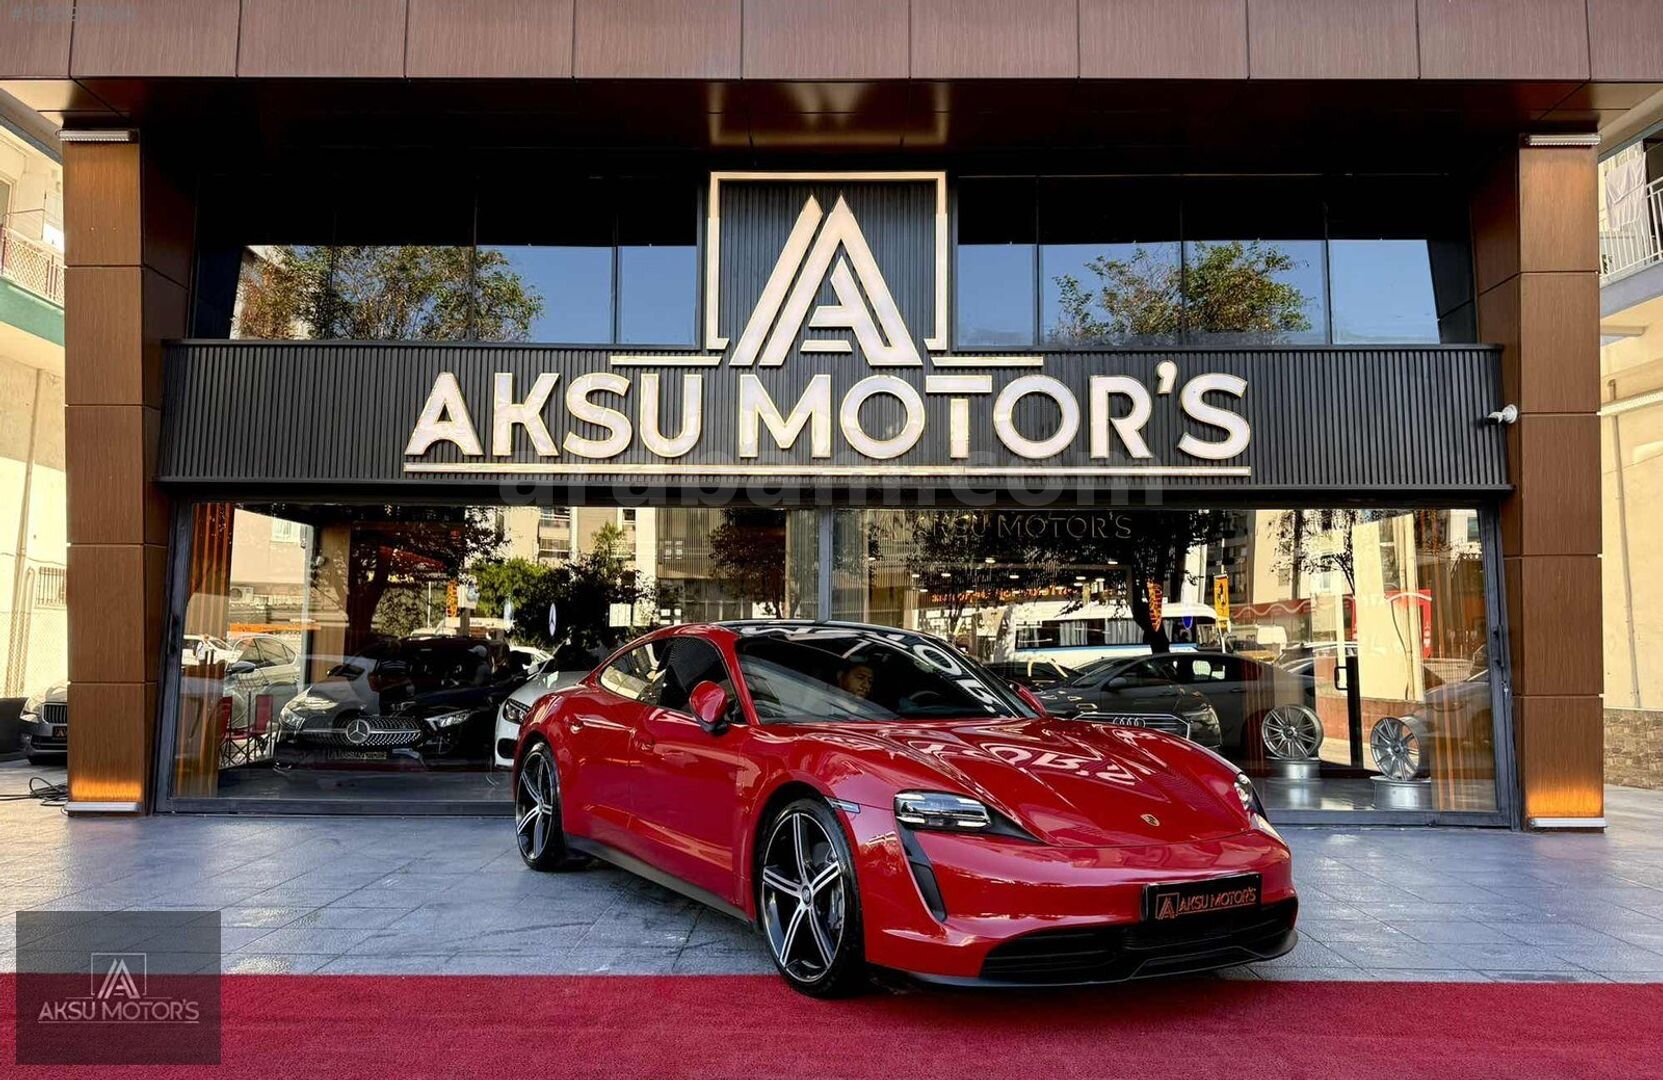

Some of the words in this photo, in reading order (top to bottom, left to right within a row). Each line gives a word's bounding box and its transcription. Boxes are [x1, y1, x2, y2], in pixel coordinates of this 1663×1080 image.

[404, 371, 702, 459] AKSU
[738, 360, 1251, 460] MOTOR'S
[997, 512, 1133, 539] MOTOR'S
[1178, 894, 1209, 912] AKSU
